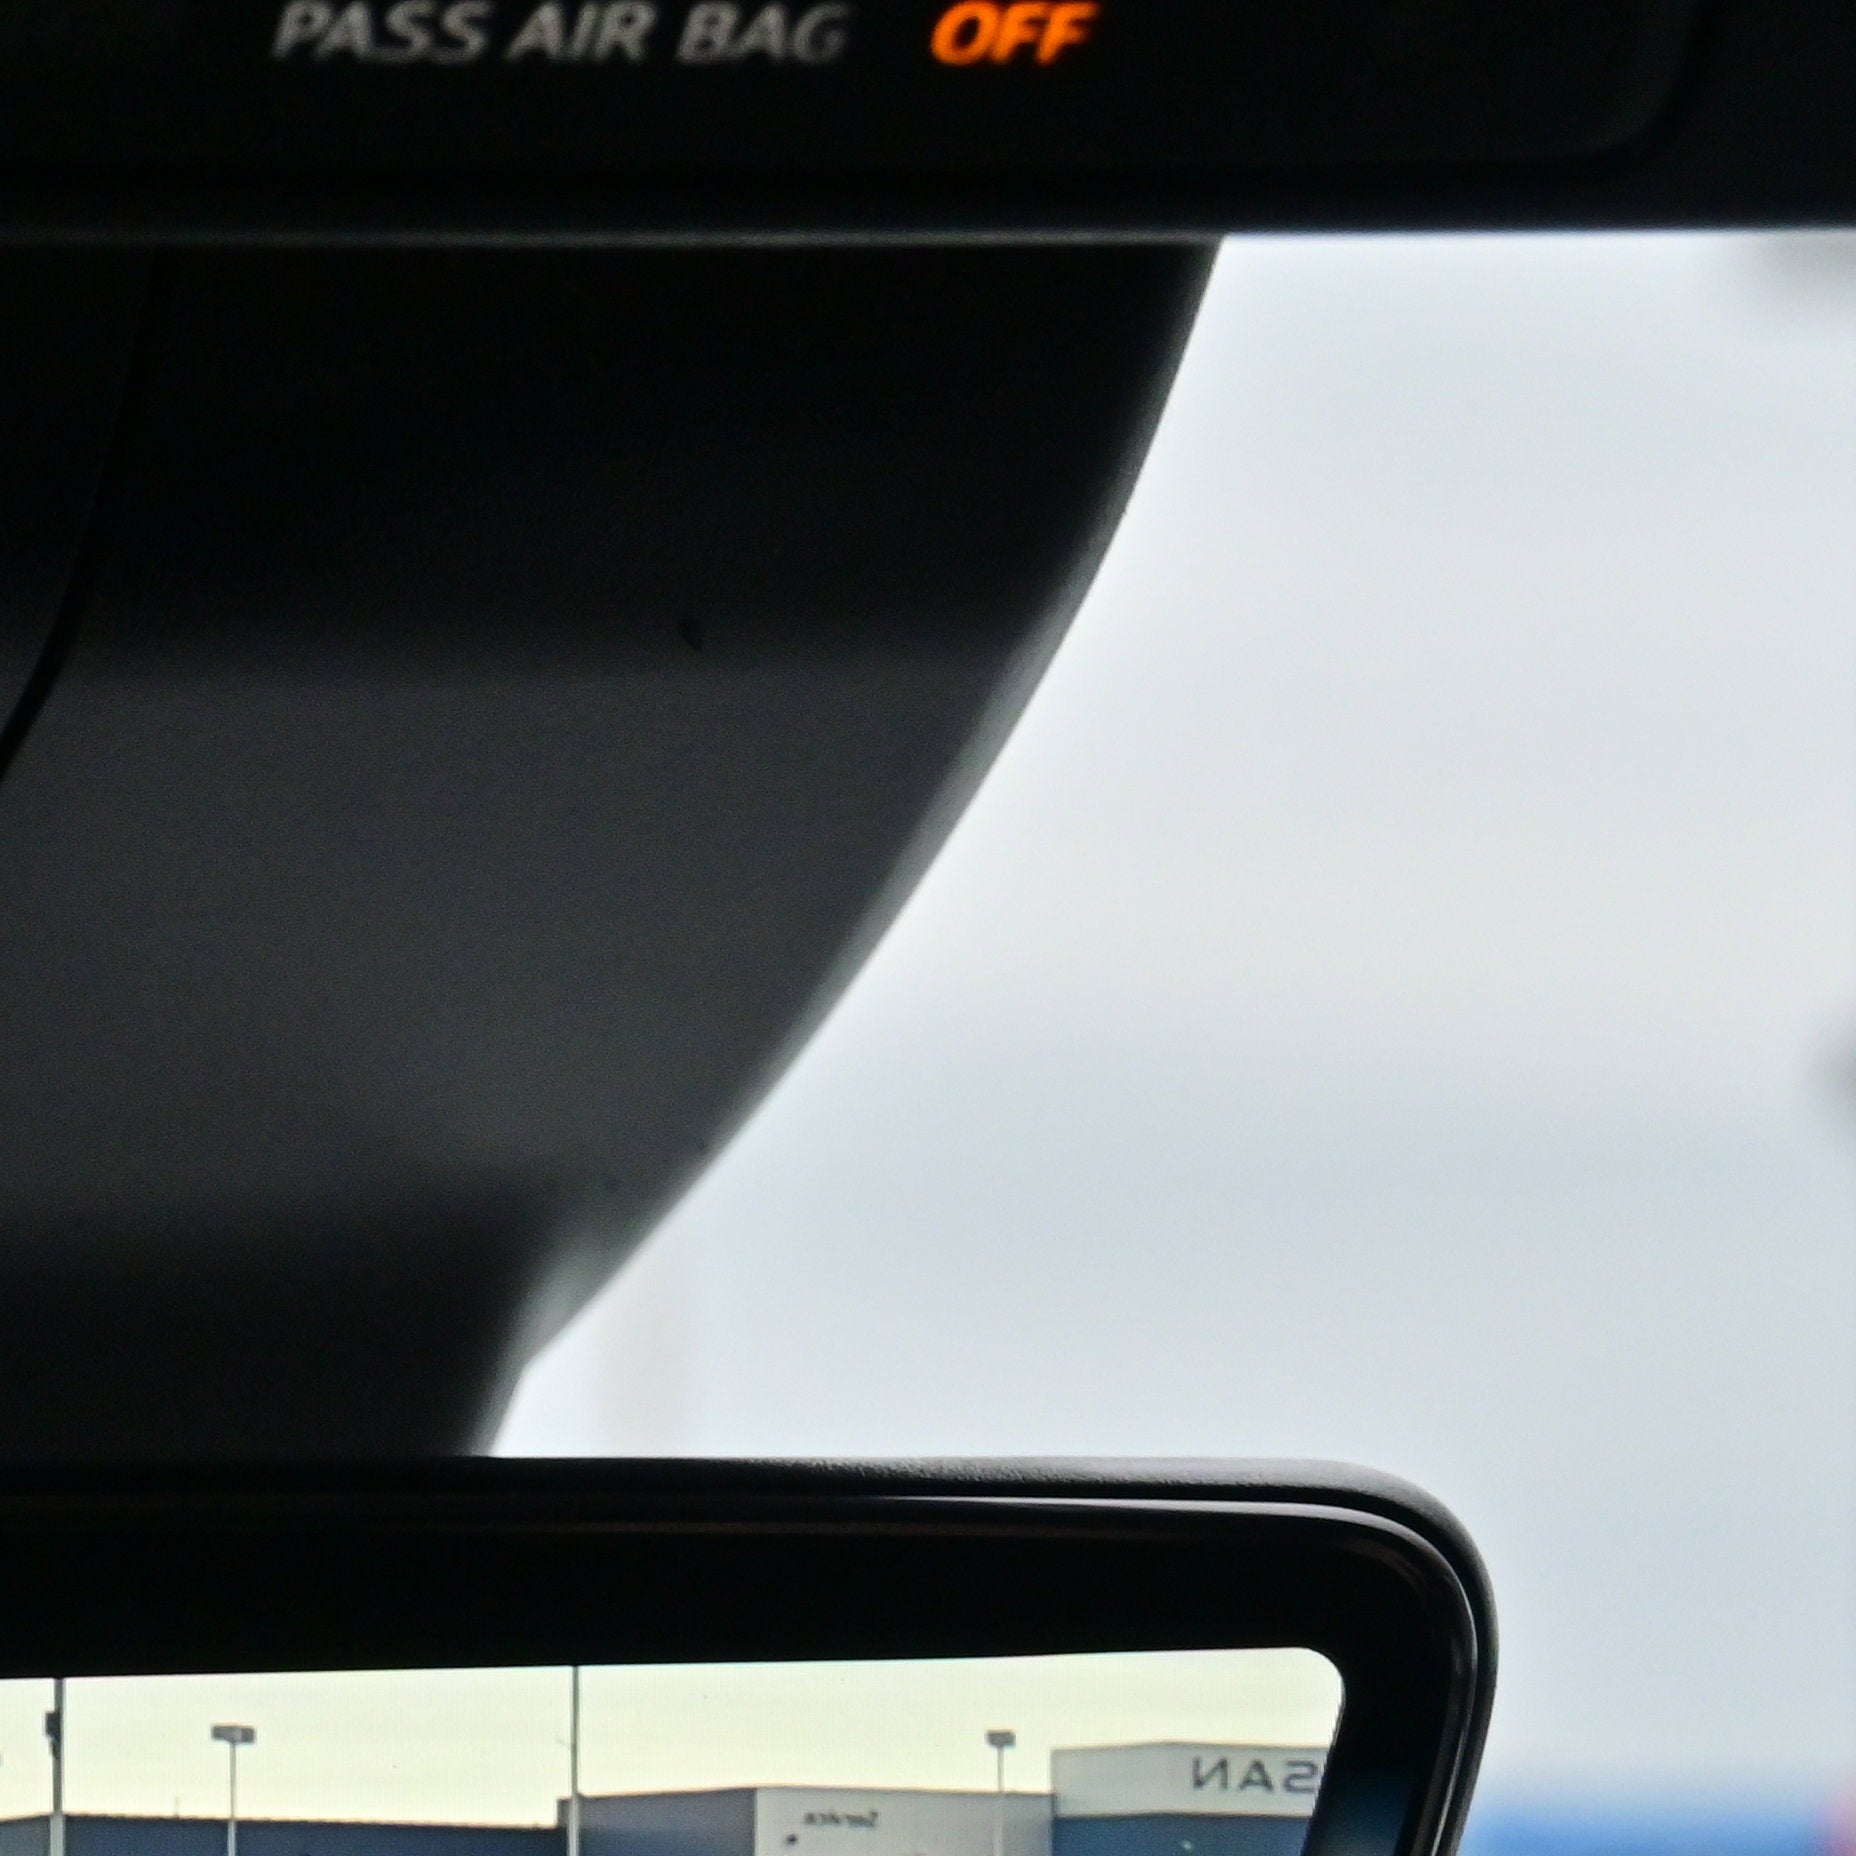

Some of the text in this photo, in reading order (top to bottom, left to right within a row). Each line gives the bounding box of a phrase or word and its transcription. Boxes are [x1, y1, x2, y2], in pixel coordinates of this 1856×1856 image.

[272, 0, 1096, 66] PASS AIR BAG OFF
